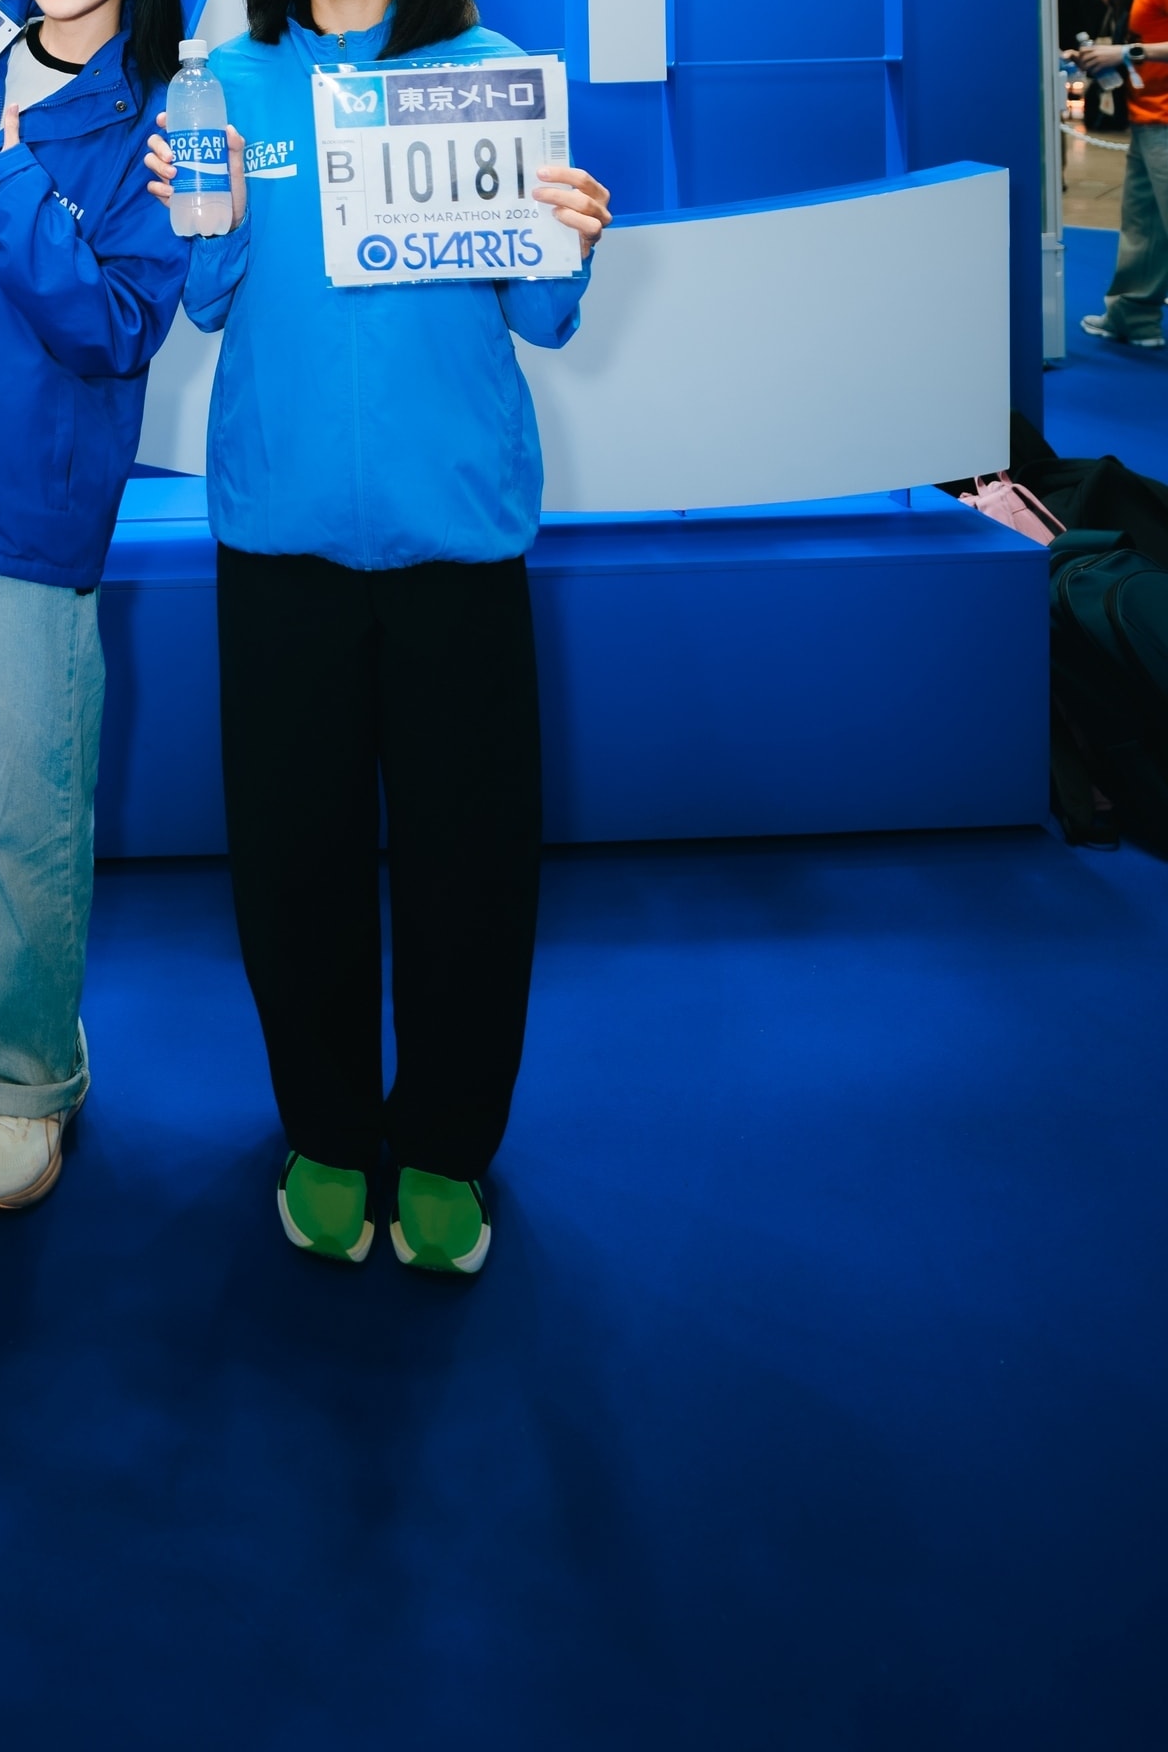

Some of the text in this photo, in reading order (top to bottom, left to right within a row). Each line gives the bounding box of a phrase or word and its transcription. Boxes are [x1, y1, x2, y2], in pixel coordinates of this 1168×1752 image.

[397, 83, 535, 113] 東京メトロ
[169, 135, 225, 150] POCARI
[245, 140, 295, 161] OCARI
[171, 147, 223, 162] SWEAT
[245, 151, 288, 171] WEAT
[326, 150, 355, 184] B
[382, 137, 525, 205] 10181
[335, 204, 346, 226] 1
[374, 208, 539, 225] TOKYO MARATHON 2026
